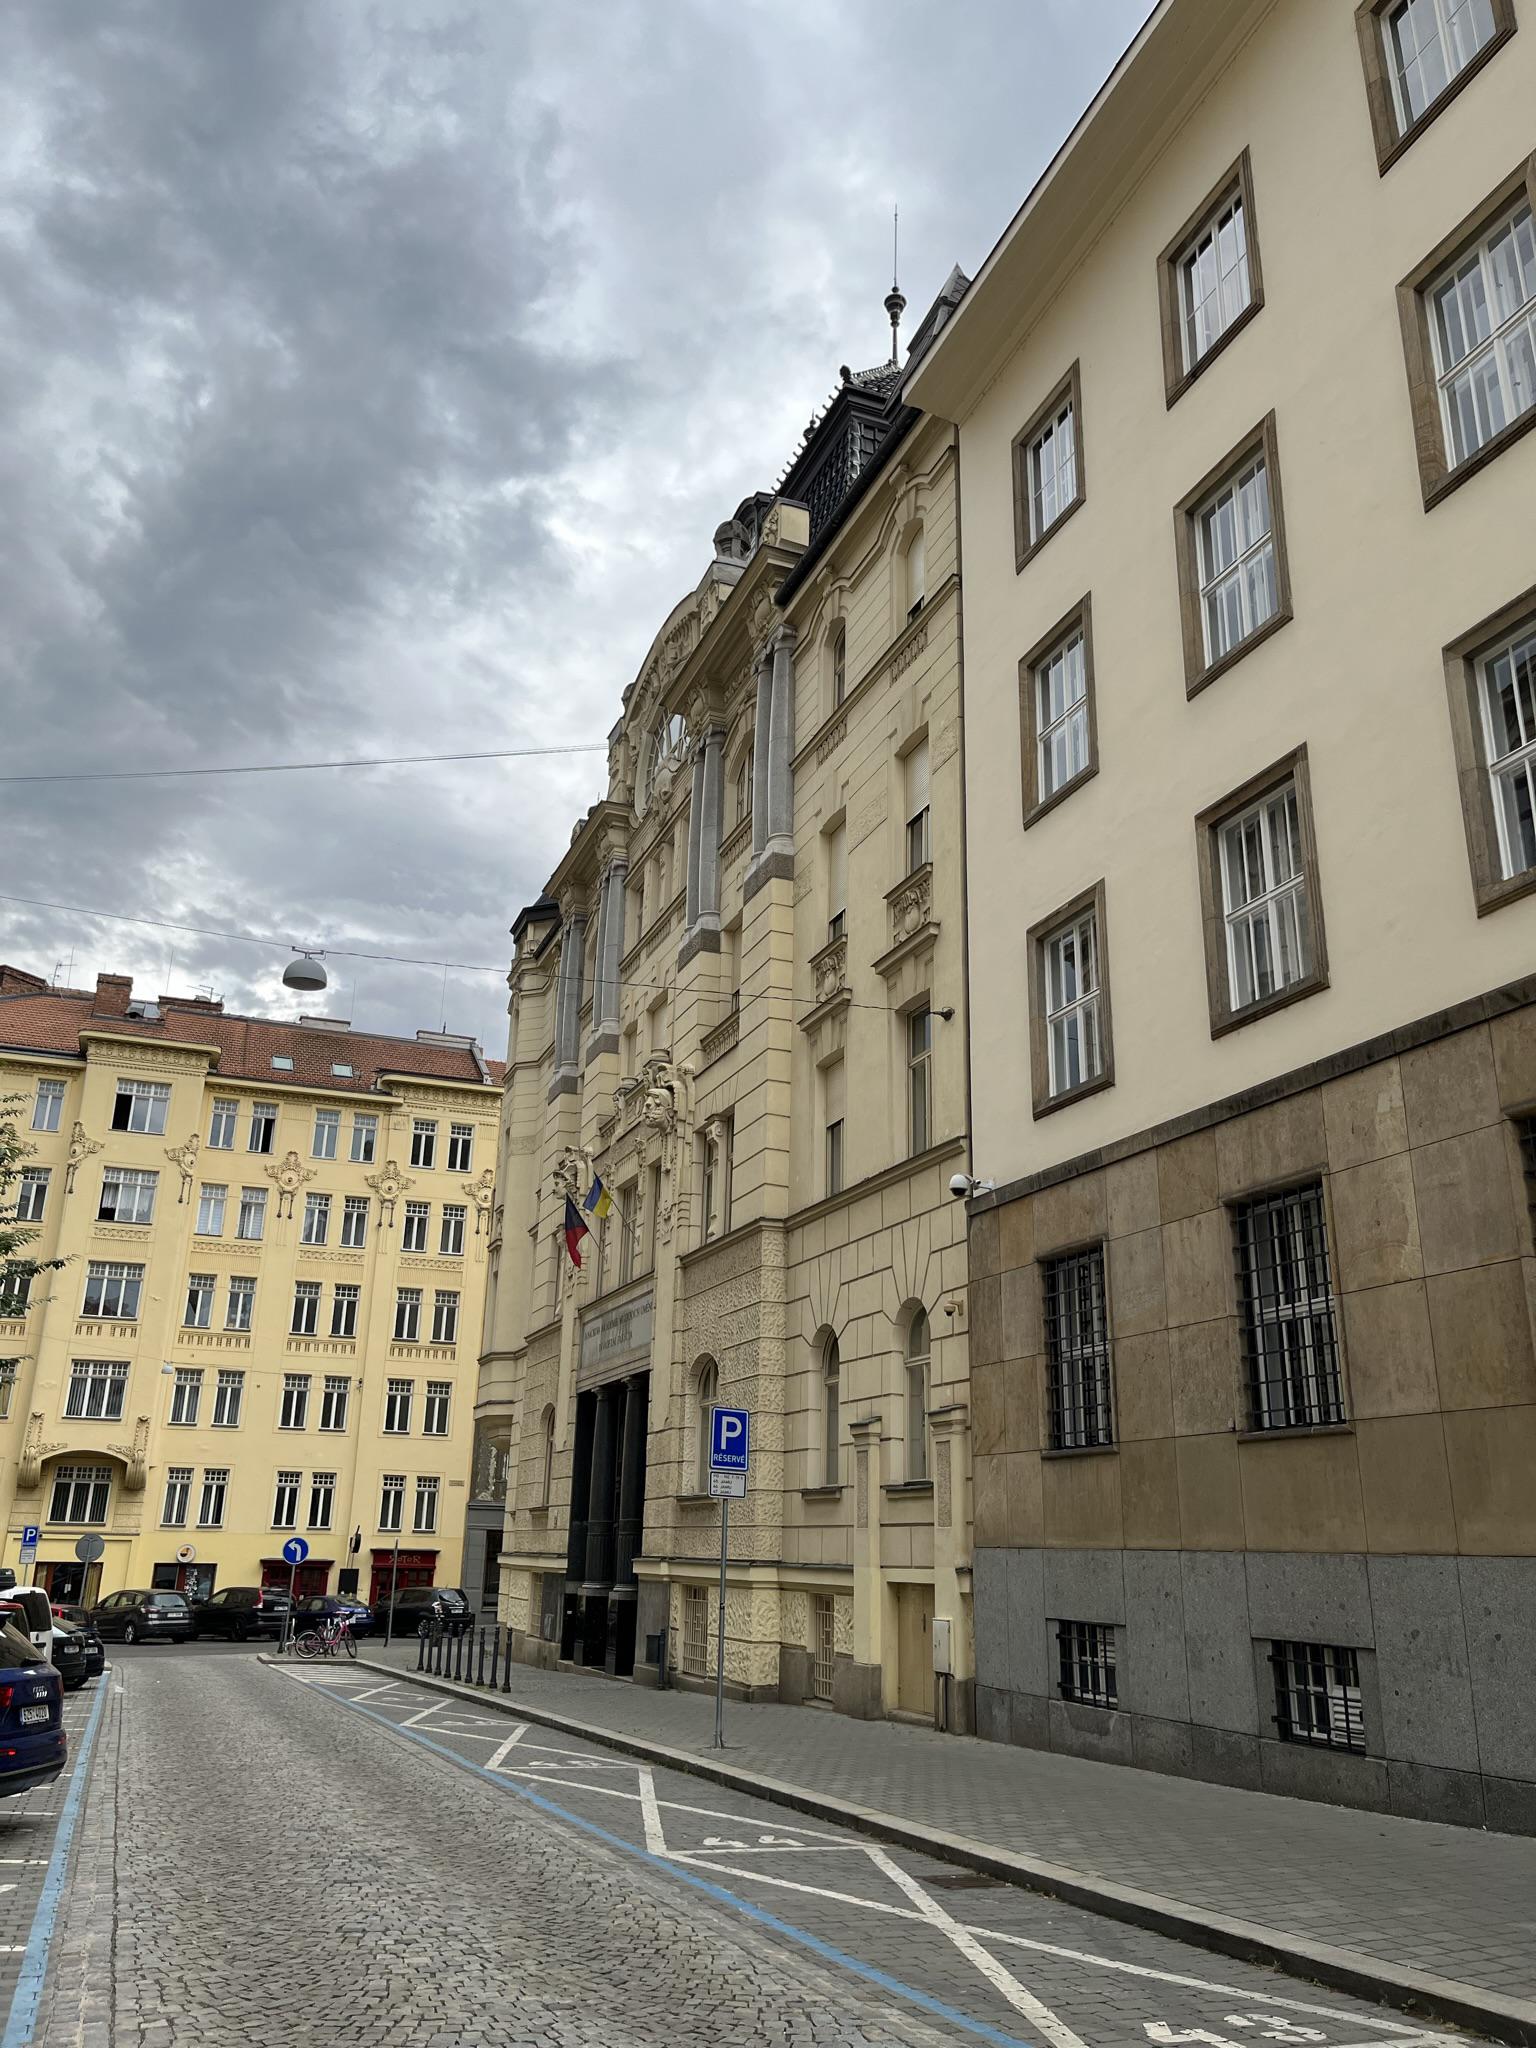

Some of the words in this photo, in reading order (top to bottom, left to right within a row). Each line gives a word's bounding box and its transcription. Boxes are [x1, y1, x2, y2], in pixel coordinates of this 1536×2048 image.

[721, 1416, 742, 1450] P
[713, 1453, 745, 1464] RÉSERVÉ
[26, 1529, 36, 1542] P
[1142, 2013, 1327, 2048] 43
